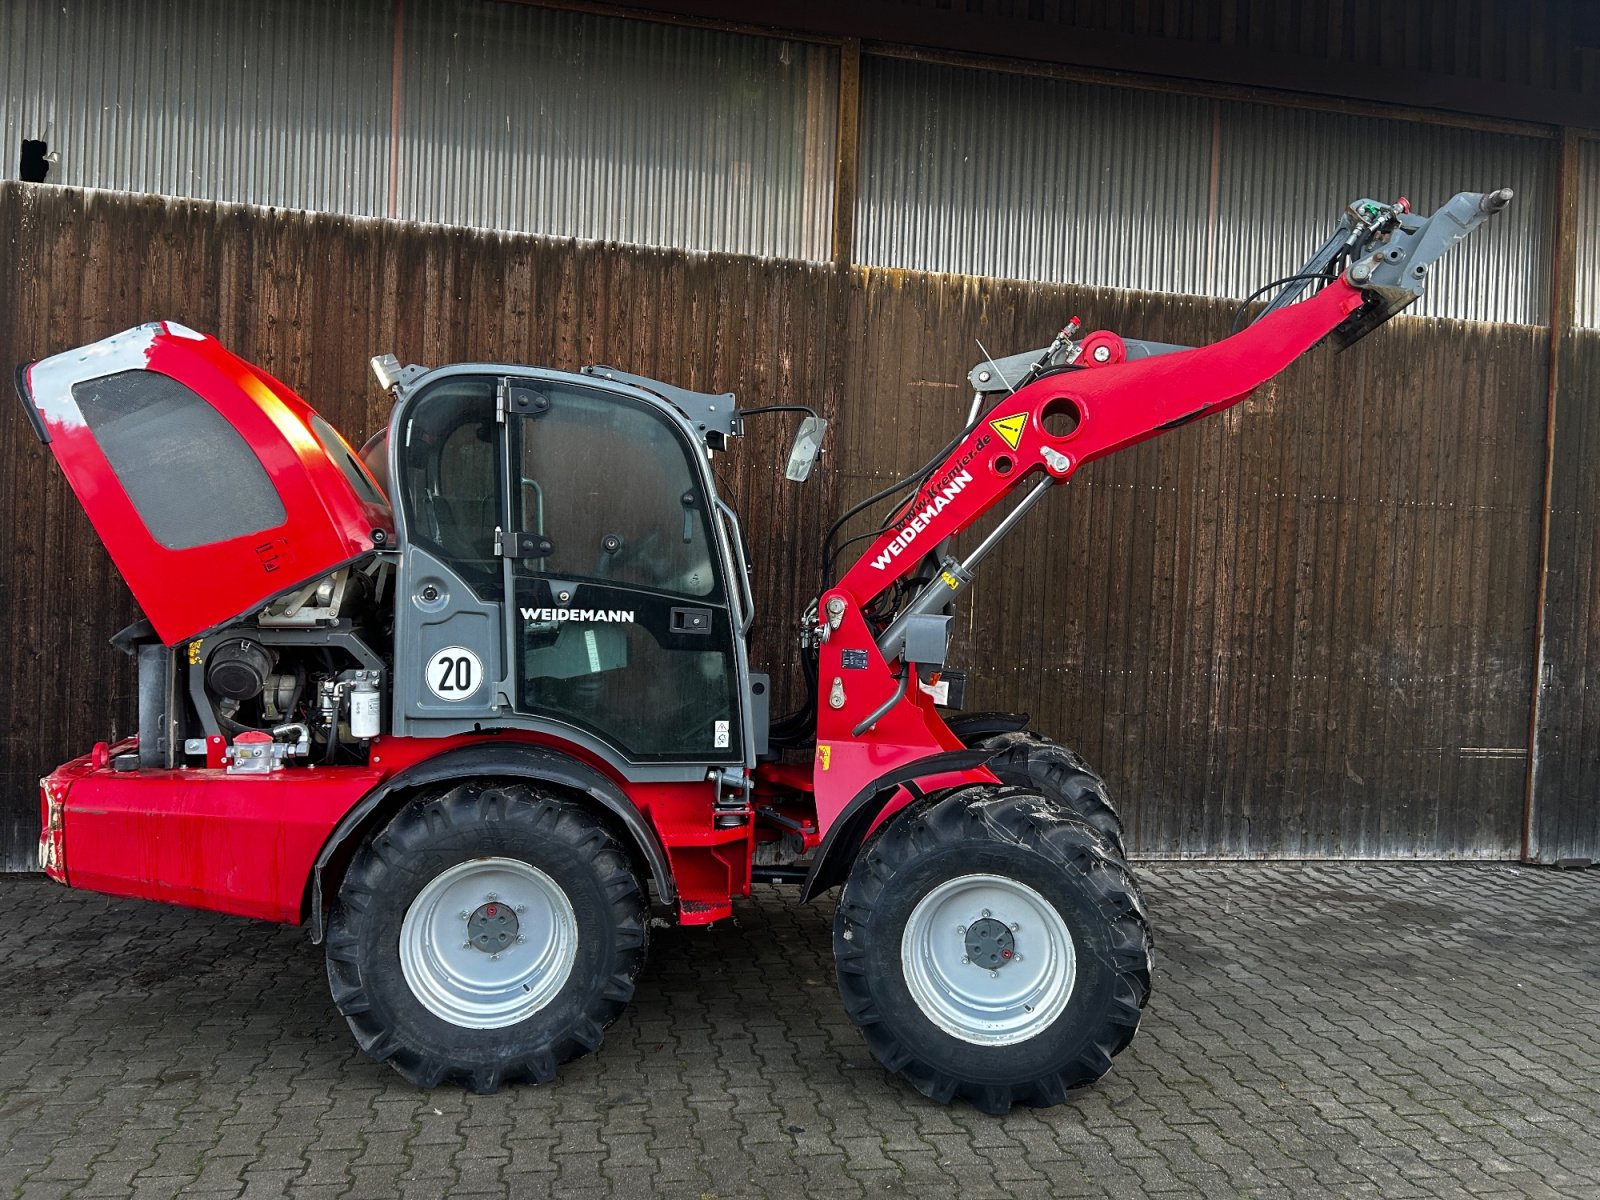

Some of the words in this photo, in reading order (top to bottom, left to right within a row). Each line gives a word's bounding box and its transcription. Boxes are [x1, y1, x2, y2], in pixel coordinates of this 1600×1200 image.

[870, 469, 973, 571] WEIDEMANN
[520, 607, 635, 623] WEIDEMANN
[438, 656, 472, 691] 20
